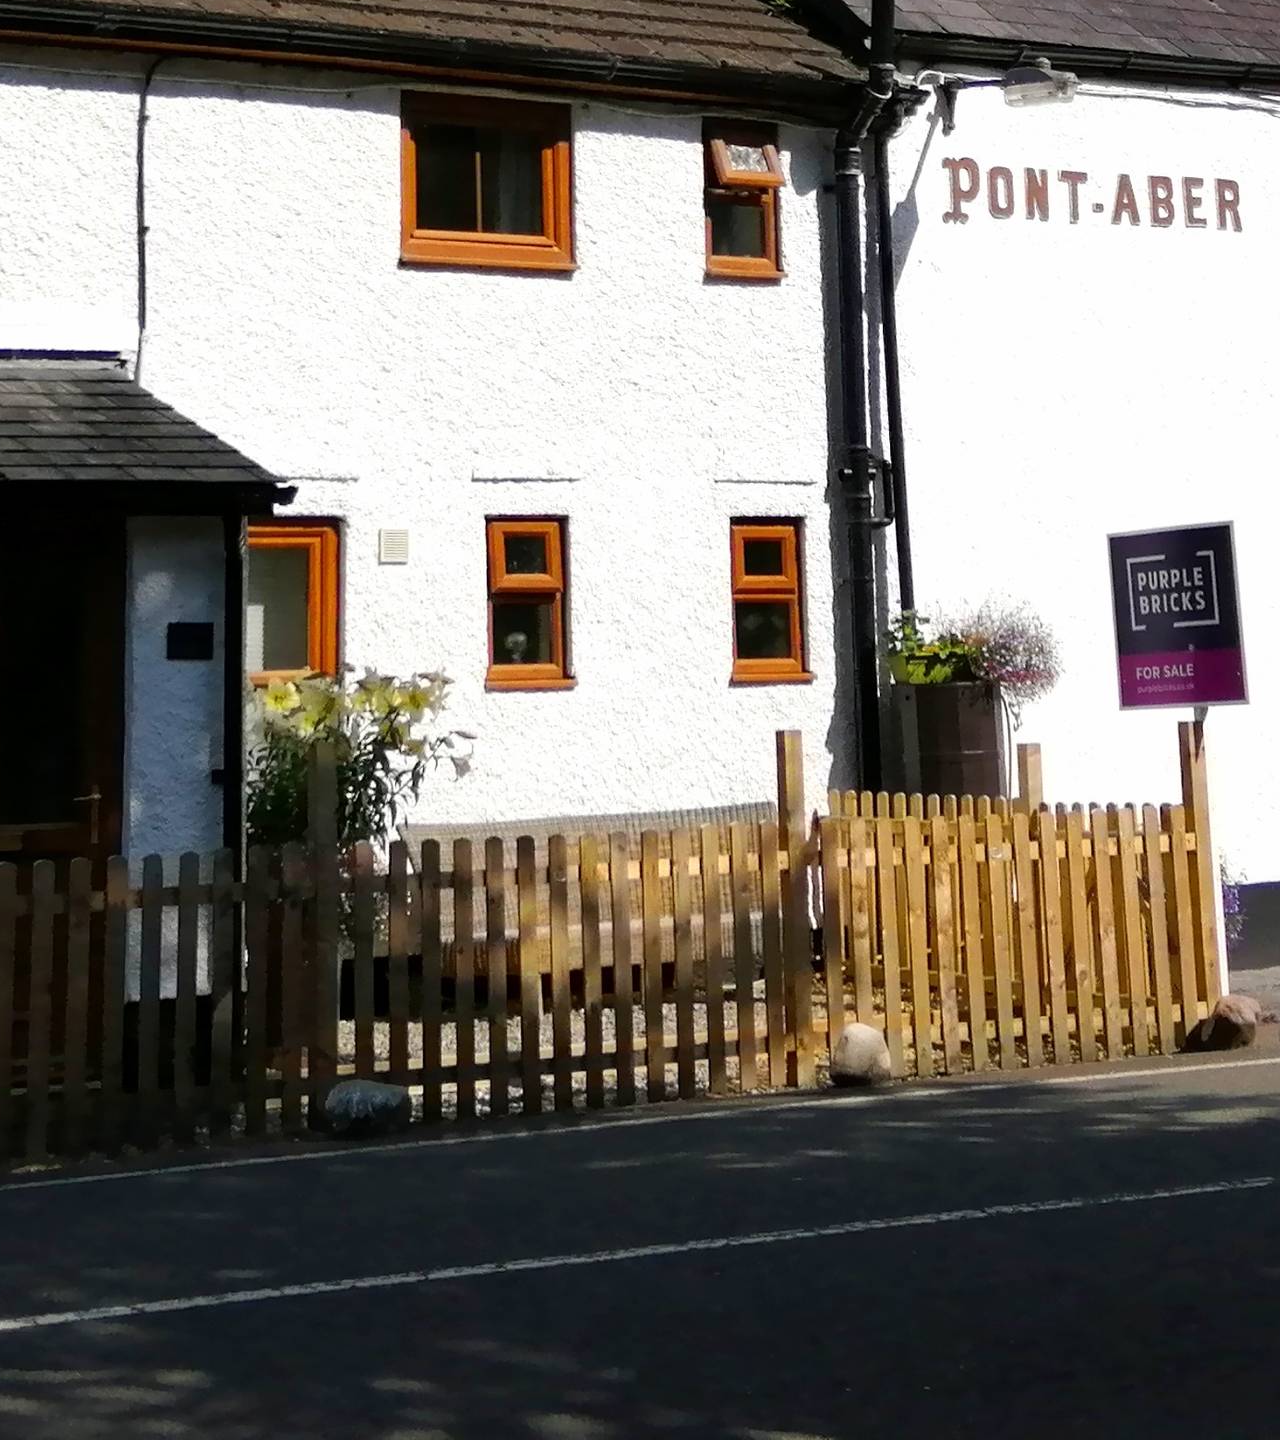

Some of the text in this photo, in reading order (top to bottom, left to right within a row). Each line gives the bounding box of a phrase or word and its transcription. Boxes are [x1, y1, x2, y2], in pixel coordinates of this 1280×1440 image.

[1137, 567, 1204, 591] PURPLE
[1139, 591, 1206, 615] BRICKS
[1136, 663, 1195, 681] FOR SALE
